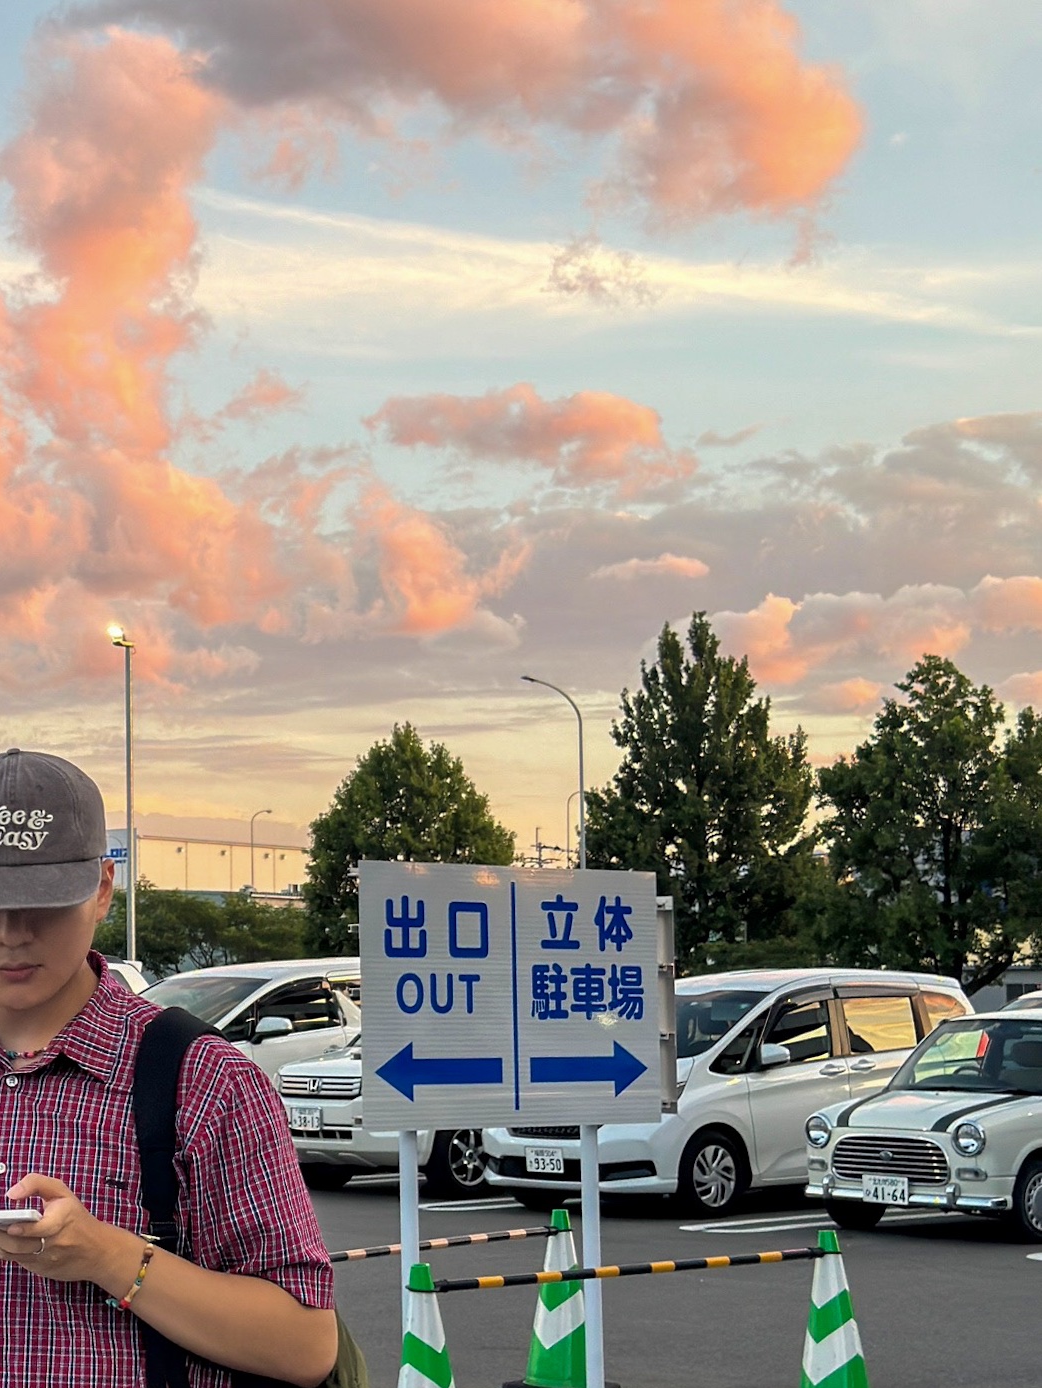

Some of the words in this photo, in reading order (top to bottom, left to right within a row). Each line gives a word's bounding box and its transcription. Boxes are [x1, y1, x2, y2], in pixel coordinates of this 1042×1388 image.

[26, 809, 54, 830] &
[384, 895, 490, 959] 出口
[540, 894, 634, 952] 立体
[396, 972, 481, 1015] OUT
[531, 963, 645, 1021] 駐車場
[872, 1186, 906, 1202] 41-64
